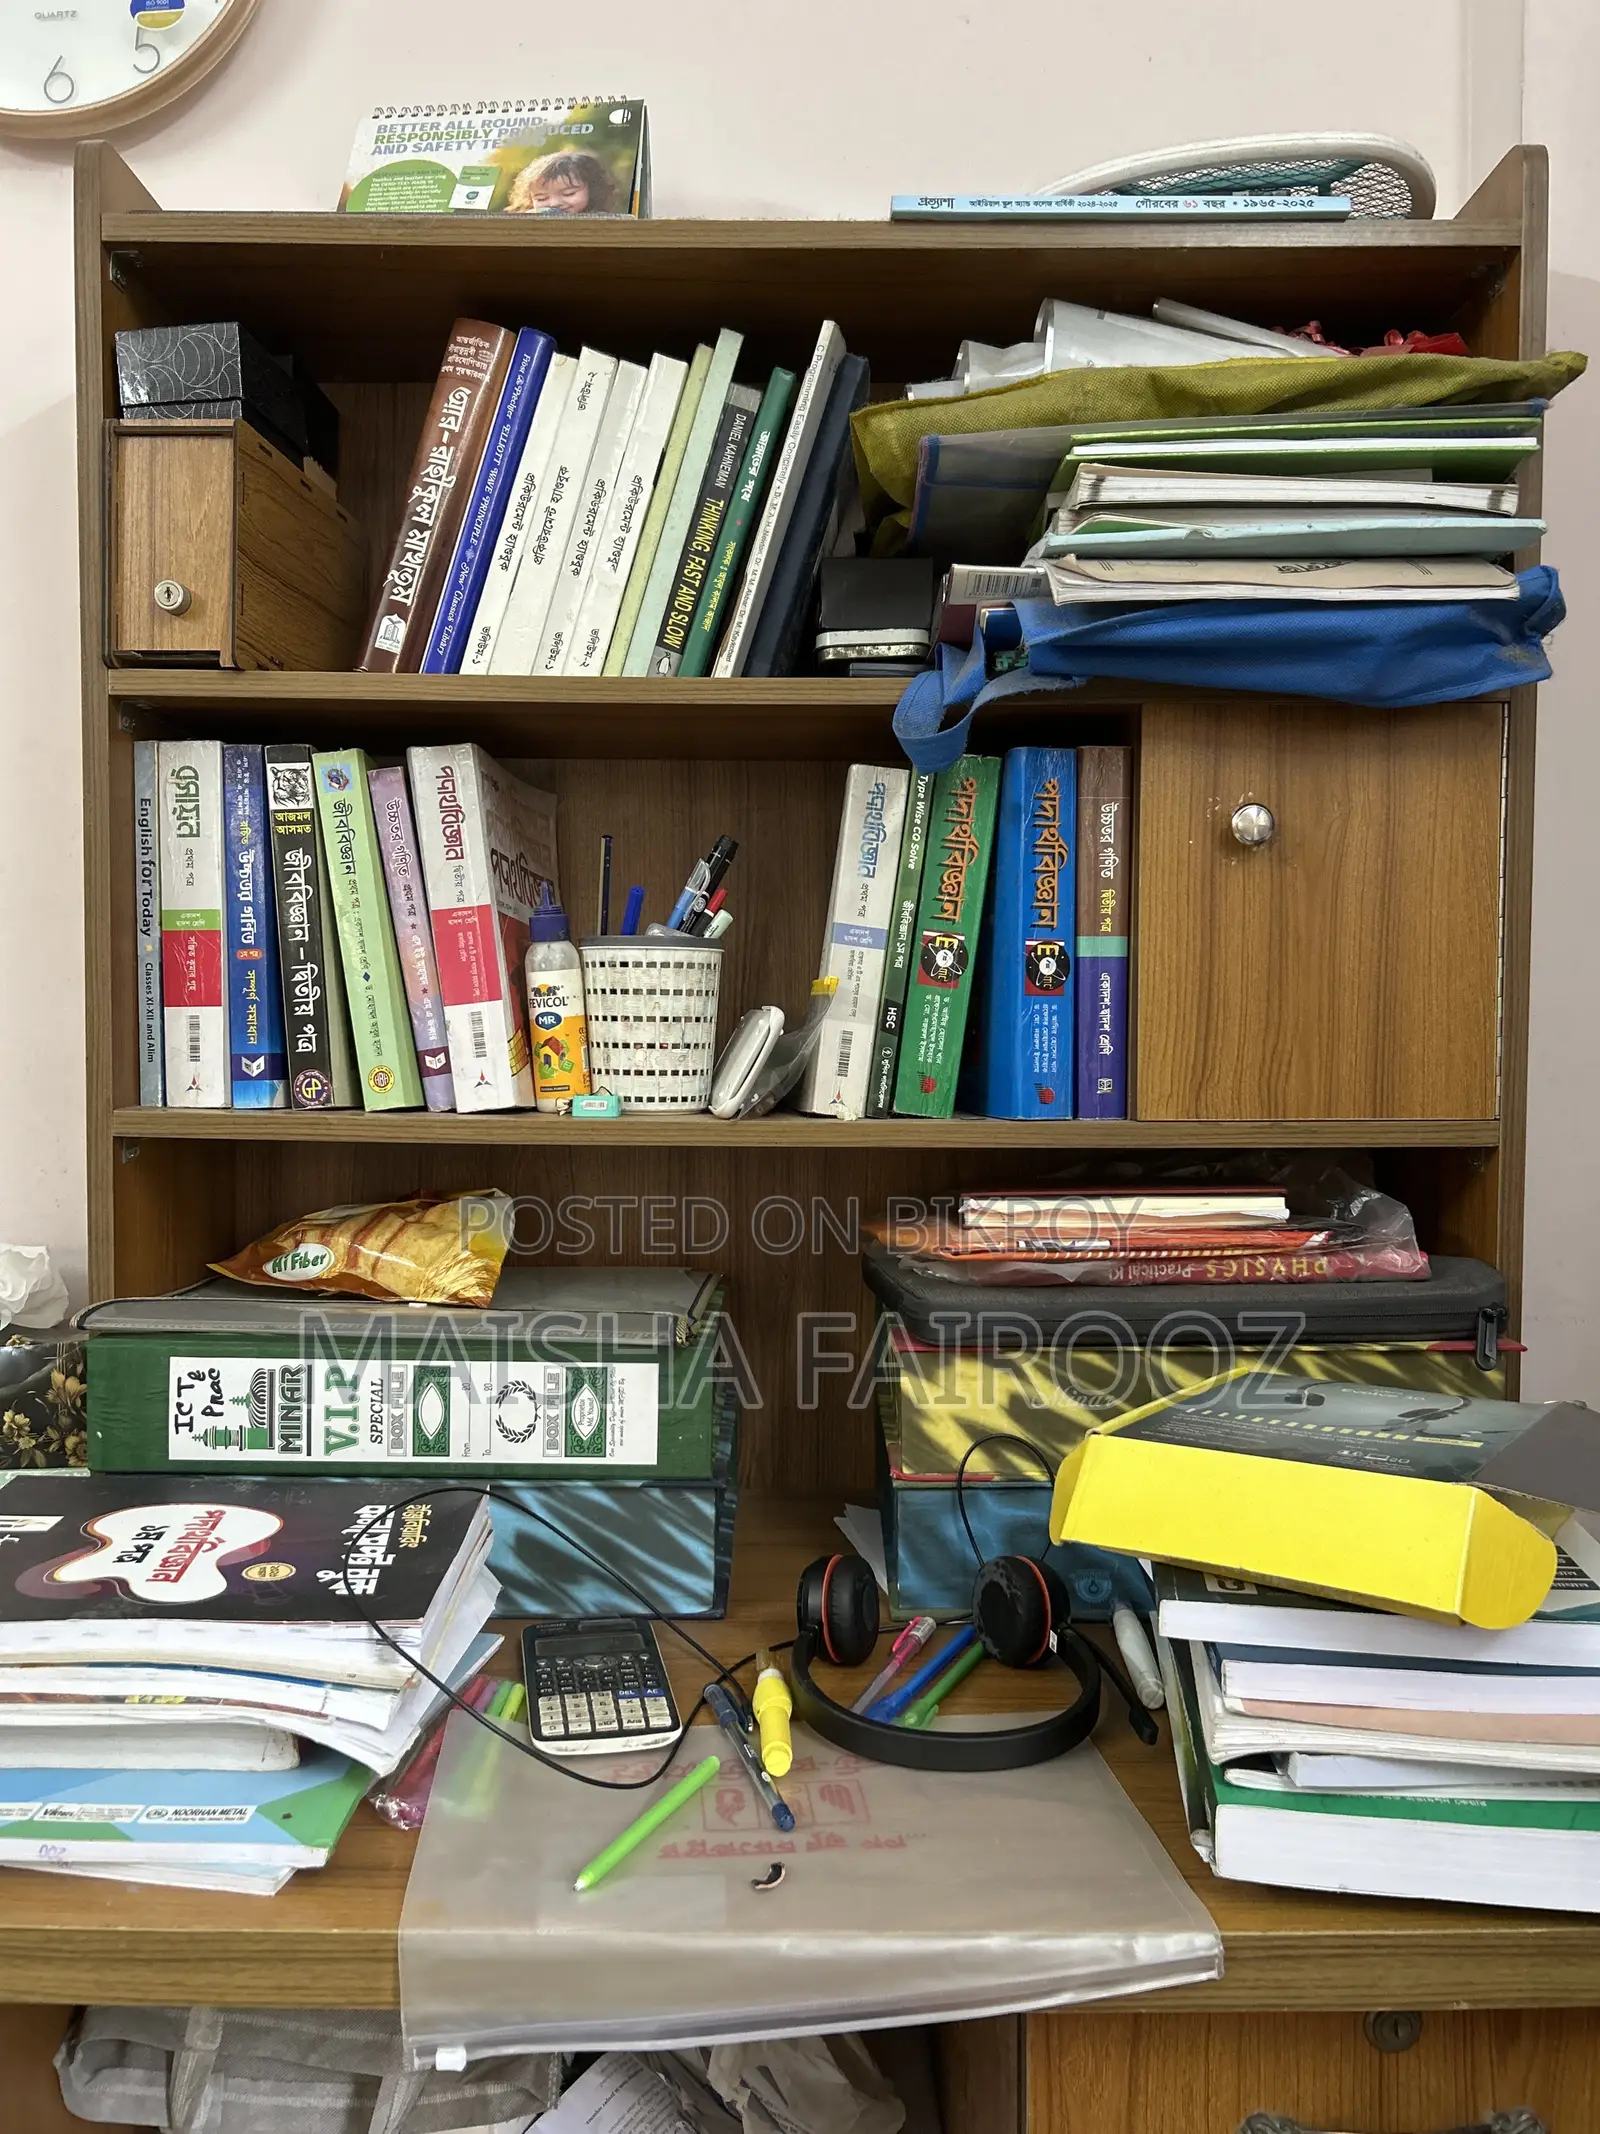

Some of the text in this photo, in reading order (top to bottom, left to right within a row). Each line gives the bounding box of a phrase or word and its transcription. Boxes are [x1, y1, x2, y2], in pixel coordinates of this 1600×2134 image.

[35, 10, 77, 20] QUARTZ
[133, 27, 160, 73] 5
[44, 55, 74, 103] 6
[374, 128, 493, 145] RESPONSIBLY
[377, 117, 548, 134] BETTER ALL ROUND:
[371, 143, 408, 156] AND
[411, 140, 476, 153] SAFETY
[917, 197, 955, 210] প্রত্যাশা
[1135, 197, 1179, 209] গৌরবের
[1203, 200, 1225, 209] বছর
[1243, 199, 1315, 208] ১৯৬৫-২০২৫
[519, 353, 531, 374] Frost
[577, 372, 597, 410] ভলিউম-২
[776, 344, 825, 484] C Programming Easily Concisely
[407, 387, 472, 527] আর-রাহীকুল
[493, 424, 511, 465] ELLIOTT
[715, 414, 746, 488] DANIEL KAHNEMAN
[484, 468, 498, 493] WAVE
[741, 431, 770, 502] জান্নাতের পথে
[470, 496, 490, 545] PRINCIPLE
[383, 529, 429, 607] মাখতূম
[663, 498, 724, 648] THINKING, FAST AND SLOW
[447, 590, 463, 622] Classics
[437, 625, 453, 655] Library
[472, 626, 491, 664] ভলিউম-১
[545, 632, 563, 670] ভলিউম-১
[580, 628, 599, 667] ভলিউম-২
[171, 766, 200, 838] রসায়ন
[274, 812, 310, 821] আজমল
[436, 766, 465, 860] পদার্থবিজ্ঞান
[908, 775, 928, 869] Type Wise CQ Solve
[275, 825, 312, 834] আসমত
[333, 799, 356, 875] জীববিজ্ঞান
[384, 798, 411, 878] উচ্চতর গণিত
[861, 782, 888, 878] পদার্থবিজ্ঞান
[934, 776, 979, 923] পদার্থবিজ্ঞান
[1099, 802, 1119, 879] উচ্চতর গণিত
[138, 798, 156, 936] English for Today
[184, 848, 194, 886] প্রথম পত্র
[1030, 778, 1067, 929] পদার্থবিজ্ঞান
[236, 849, 256, 944] উচ্চতর গণিত
[284, 848, 312, 941] জীববিজ্ঞান
[453, 864, 465, 887] দ্বিতীয়
[456, 890, 464, 902] পত্র
[403, 884, 416, 916] প্রথম পত্র
[857, 883, 868, 918] প্রথম পত্র
[1100, 888, 1116, 932] দ্বিতীয় পত্র
[894, 900, 914, 968] জীববিজ্ঞান ১ম পত্র
[291, 962, 320, 1016] দ্বিতীয়
[529, 997, 568, 1008] FEVICOL
[145, 962, 155, 1062] Classes XI-XII and Alim
[246, 1004, 257, 1044] সমাধান
[538, 1015, 556, 1024] MR
[886, 1007, 897, 1028] HSC
[1099, 972, 1113, 1055] একাদশ-দ্বাদশ শ্রেণি
[296, 1024, 317, 1052] পত্র
[271, 1252, 327, 1274] Hi Fiber
[1128, 1257, 1329, 1279] PHYSICS Practical
[174, 1377, 195, 1435] ICT
[484, 1383, 492, 1392] 20
[278, 1364, 306, 1455] MINAR
[370, 1378, 384, 1445] SPECIAL
[391, 1371, 404, 1450] BOX FILE
[462, 1382, 471, 1458] From 20
[547, 1373, 560, 1450] BOX FILE
[578, 1399, 586, 1426] Proprietor
[111, 1524, 171, 1564] ১ম পত্র
[145, 1508, 227, 1584] পদার্থবিজ্ঞান
[171, 1809, 218, 1817] NOORHAN
[219, 1808, 248, 1816] METAL
